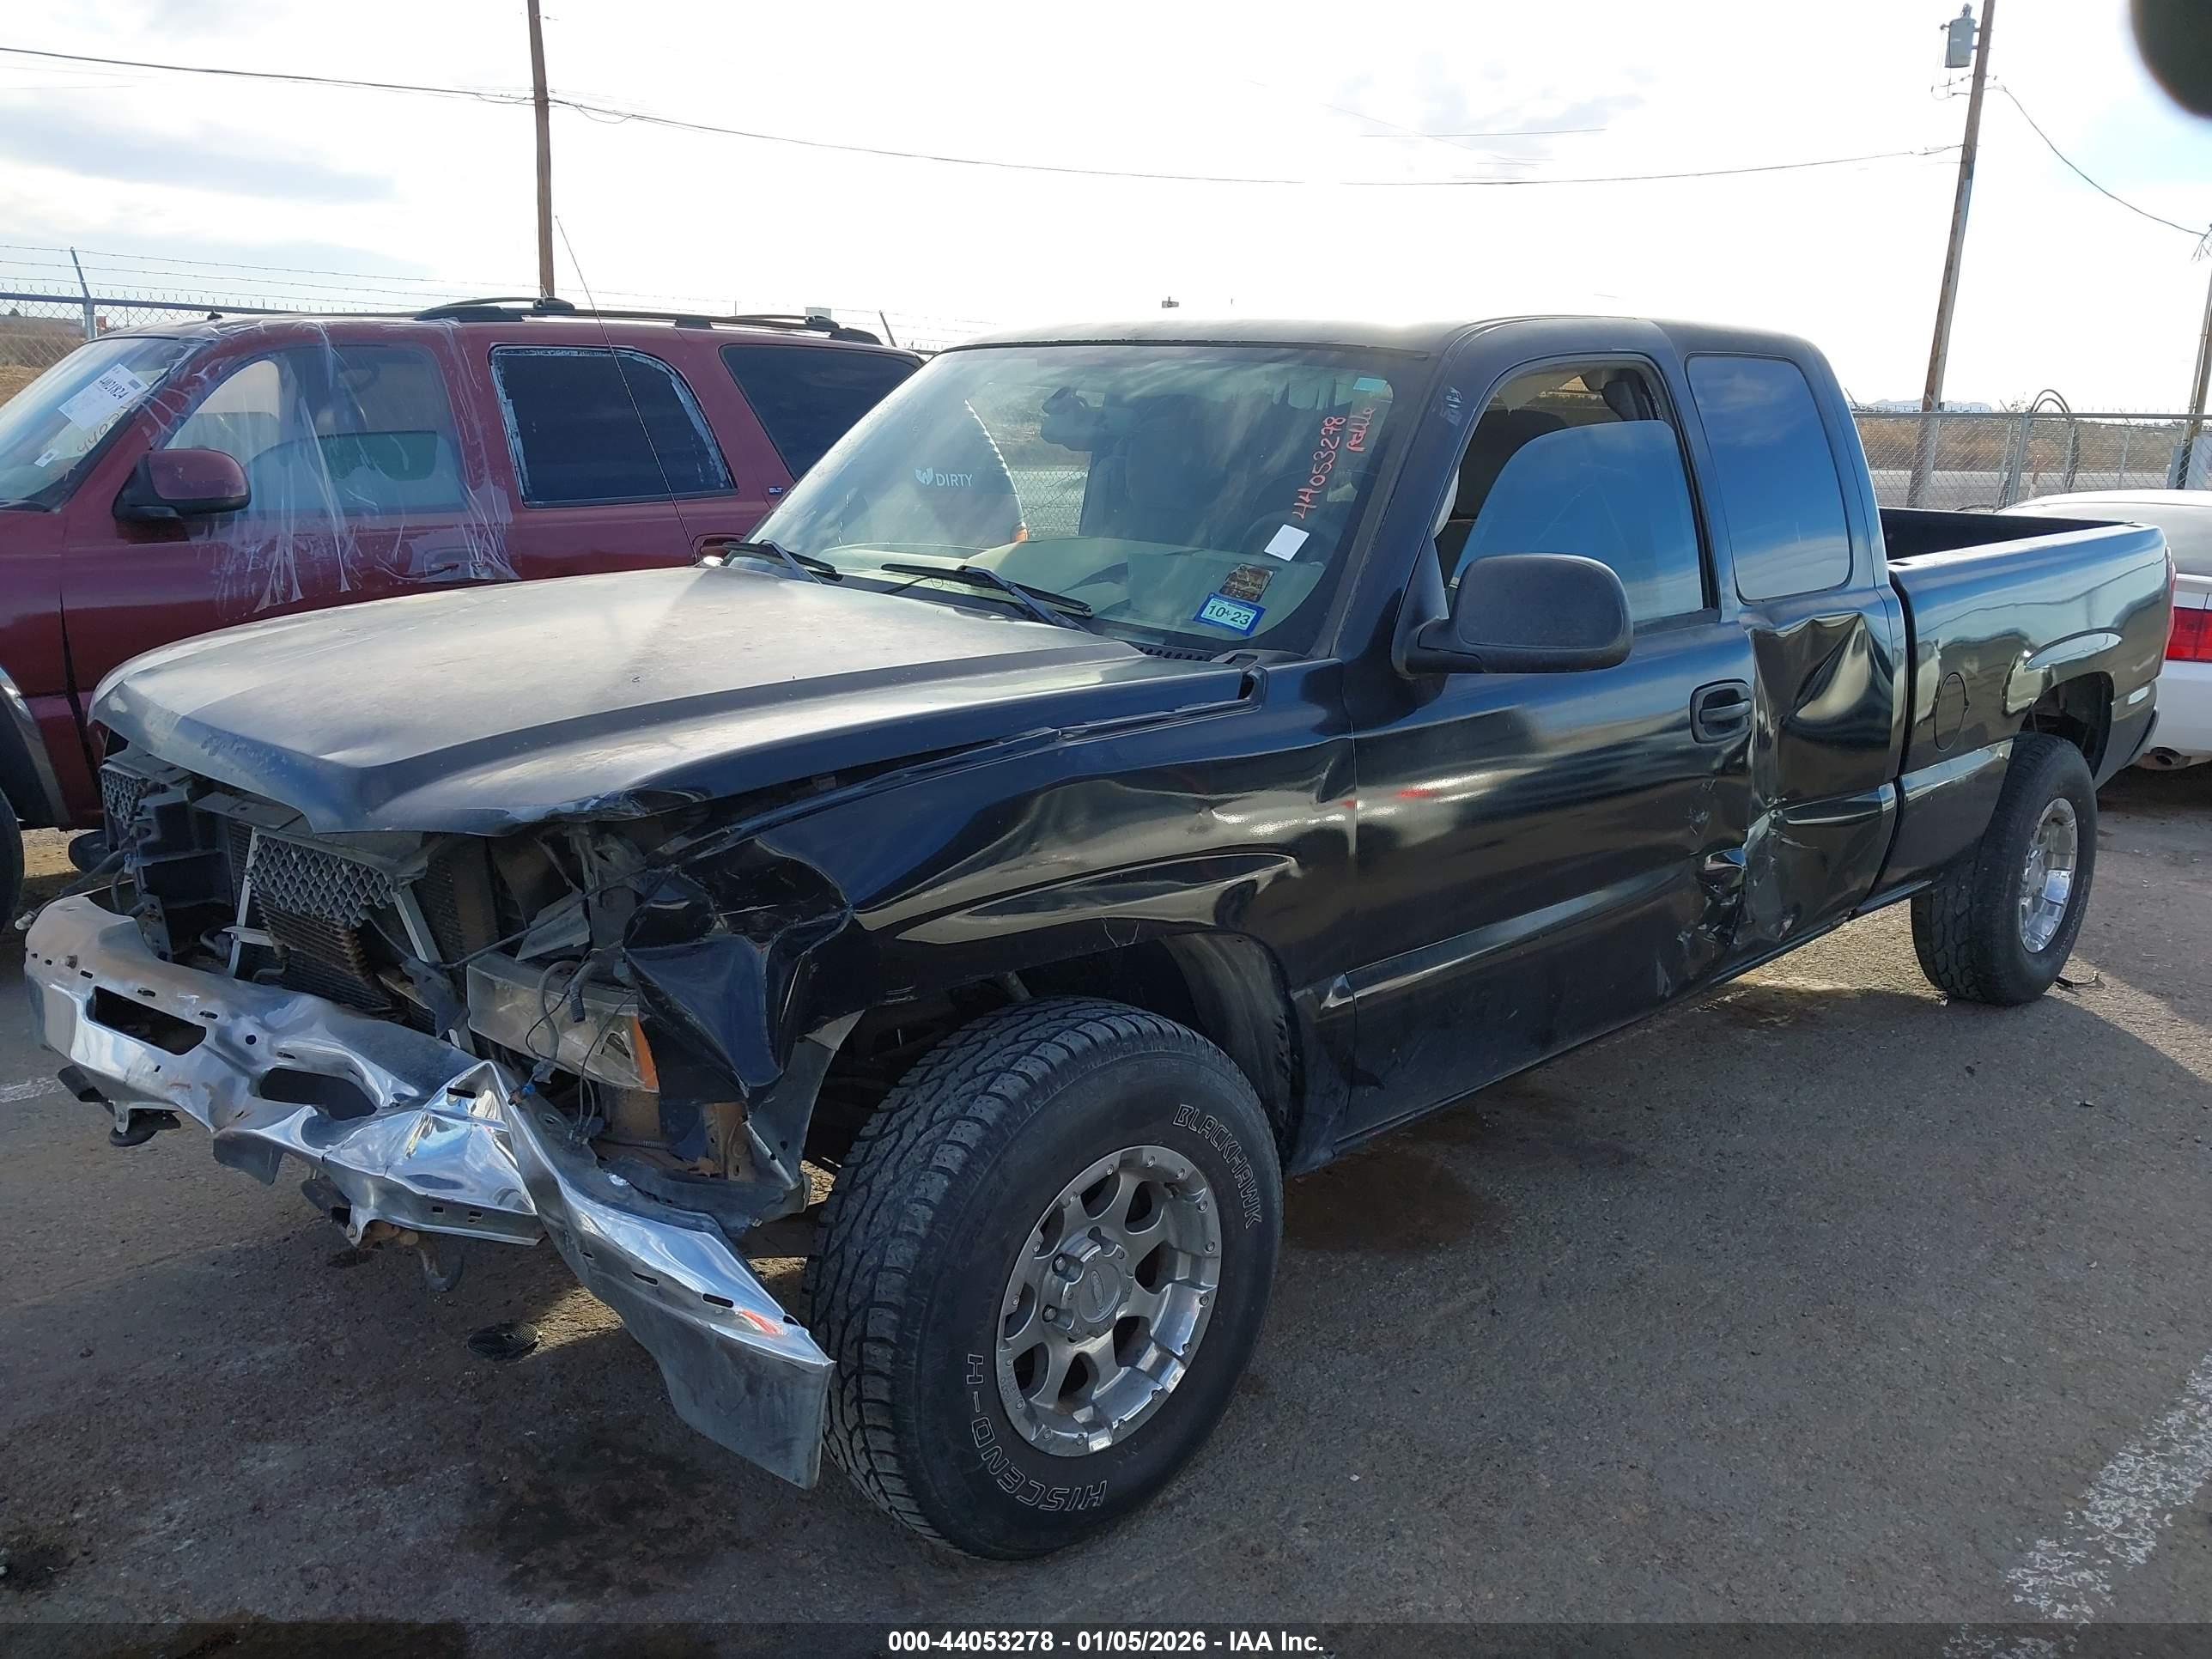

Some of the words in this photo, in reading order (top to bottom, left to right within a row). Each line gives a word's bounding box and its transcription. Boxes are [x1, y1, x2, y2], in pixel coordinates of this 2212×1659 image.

[935, 473, 973, 487] DIRTY
[1291, 416, 1346, 520] 44053278
[1173, 1103, 1262, 1229] BLACKHAWK
